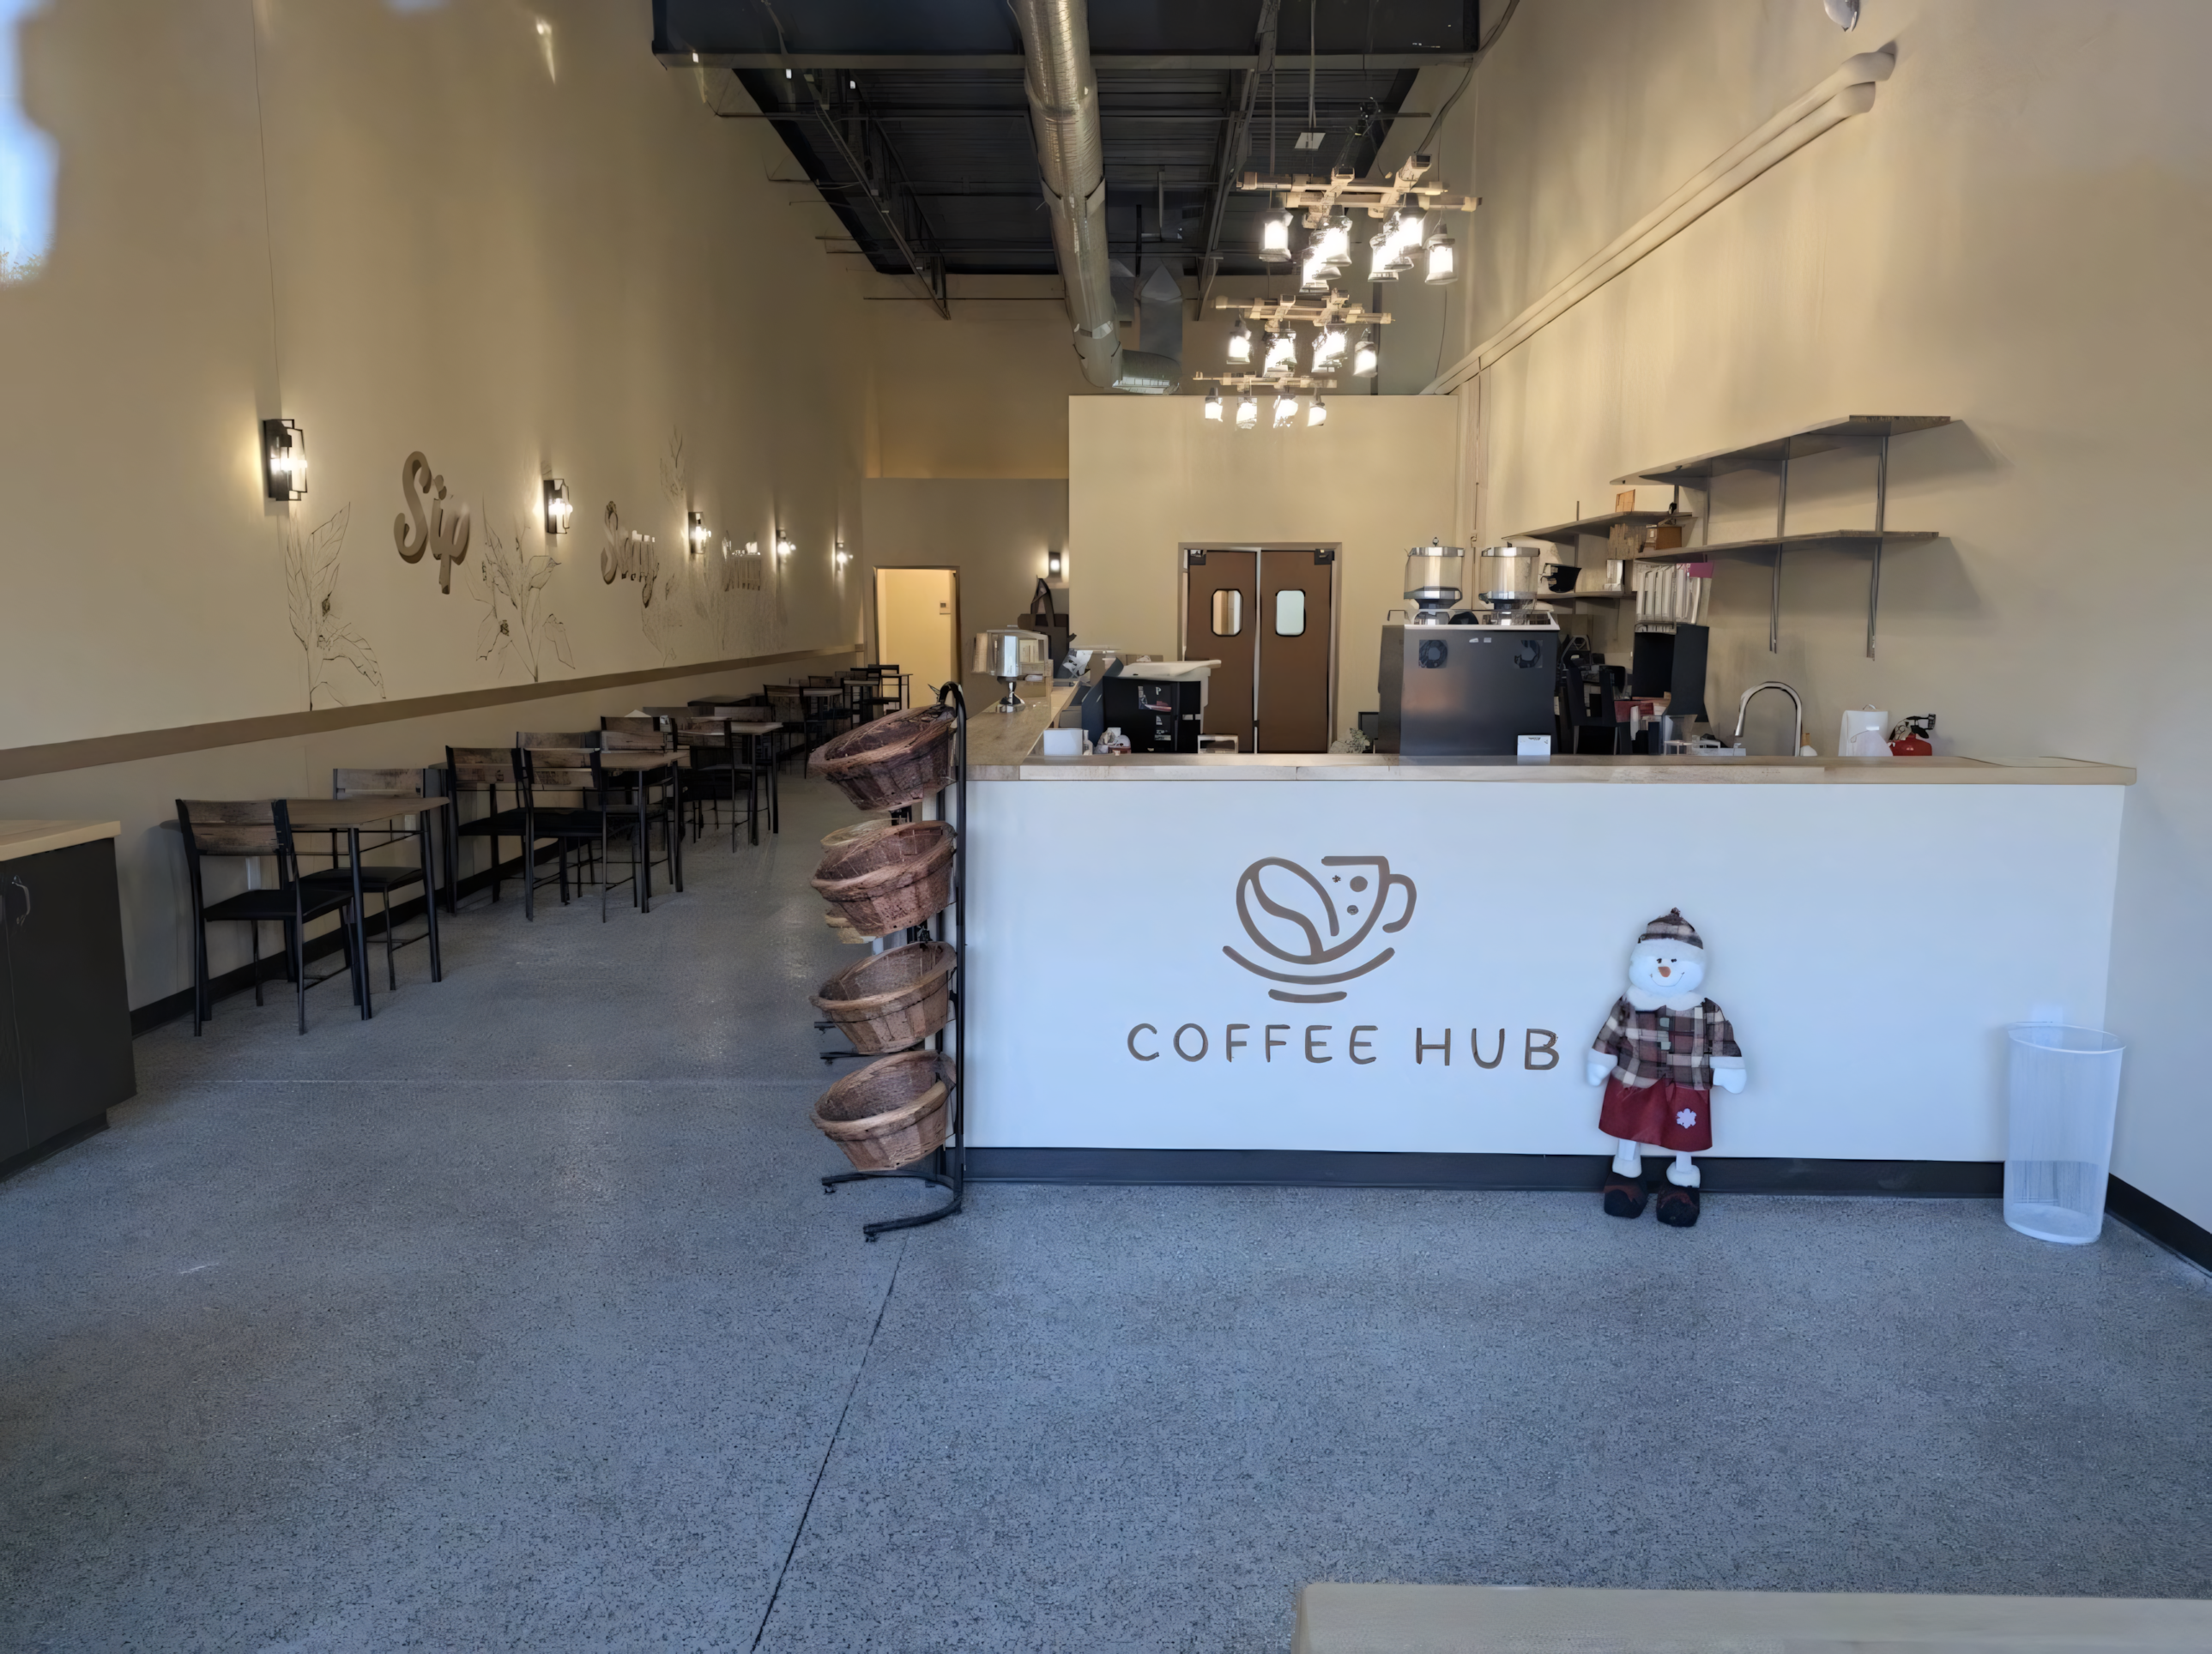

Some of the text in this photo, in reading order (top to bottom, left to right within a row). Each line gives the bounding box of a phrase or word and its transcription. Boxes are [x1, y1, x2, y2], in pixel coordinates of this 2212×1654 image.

[393, 450, 471, 595] Sip
[1127, 1023, 1560, 1071] COFFEE HUB
